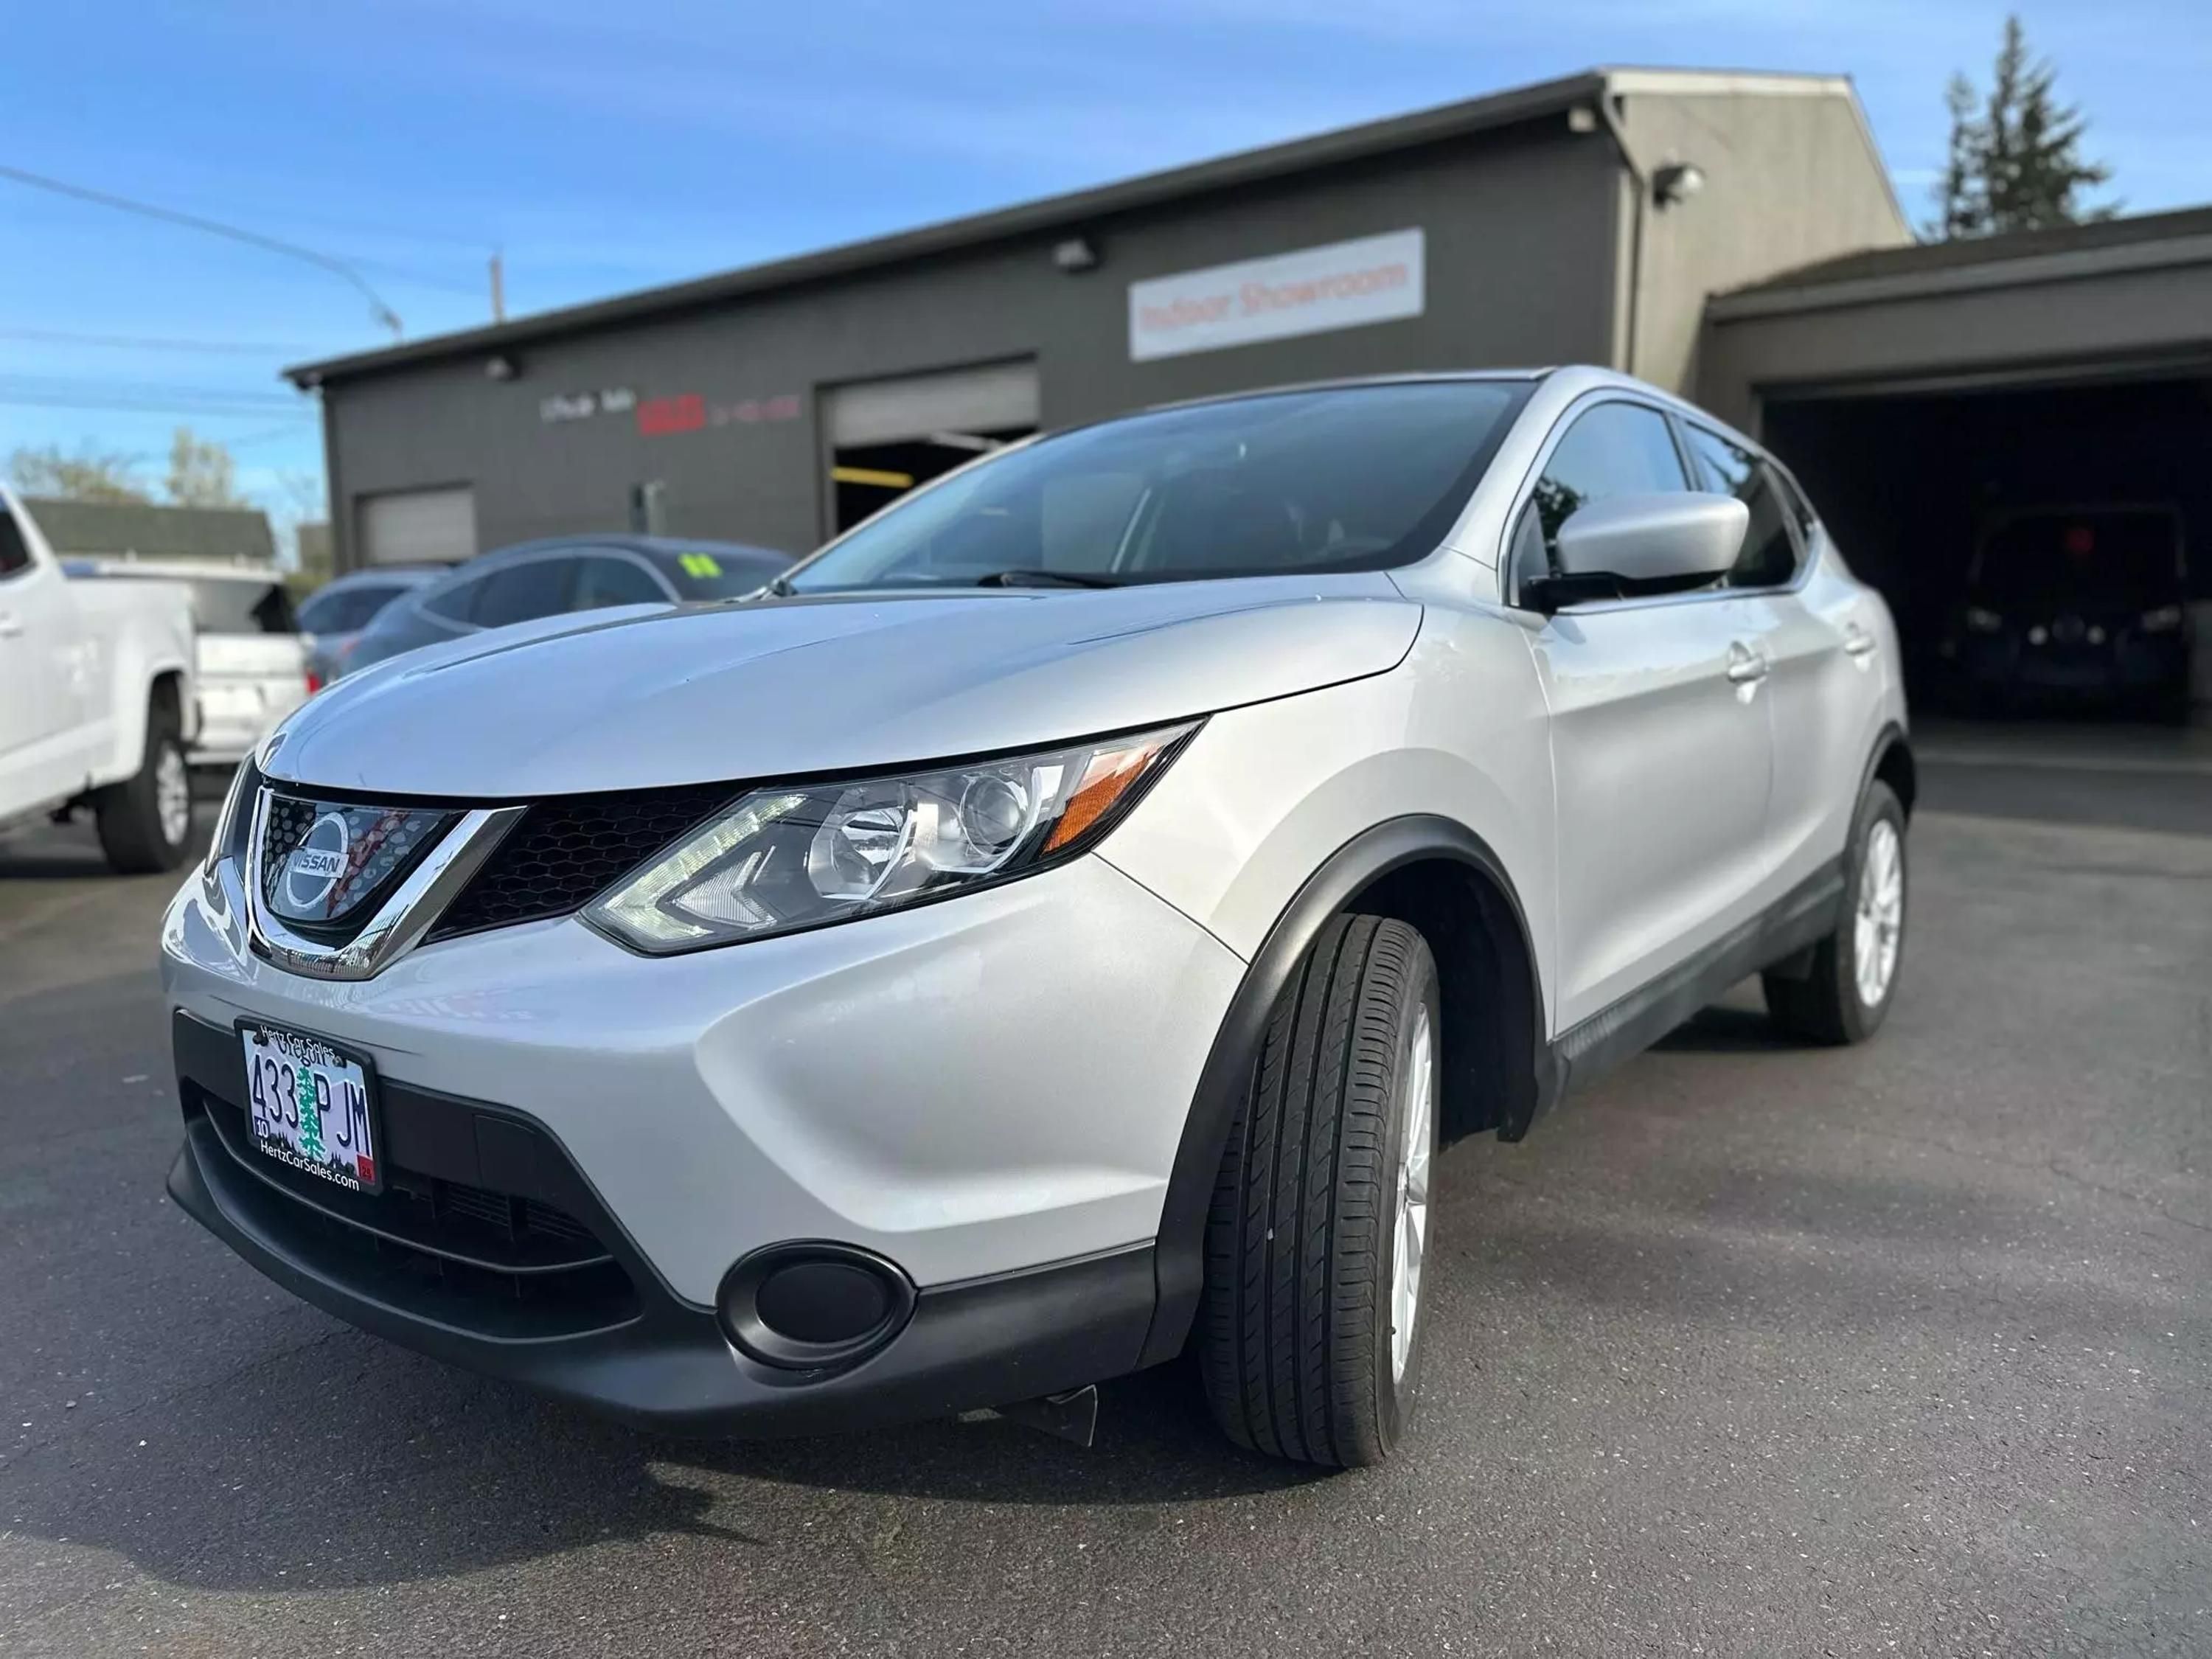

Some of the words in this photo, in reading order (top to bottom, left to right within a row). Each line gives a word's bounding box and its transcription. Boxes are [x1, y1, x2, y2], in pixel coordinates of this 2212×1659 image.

[1141, 296, 1228, 330] Indoor
[1239, 263, 1407, 316] Showroom
[292, 854, 340, 872] NISSAN
[260, 1025, 285, 1044] Hertz
[286, 1033, 306, 1054] Car
[306, 1038, 335, 1059] Sales
[253, 1054, 298, 1128] 433
[314, 1073, 370, 1157] PJM
[260, 1140, 360, 1192] HertzCarSales.com
